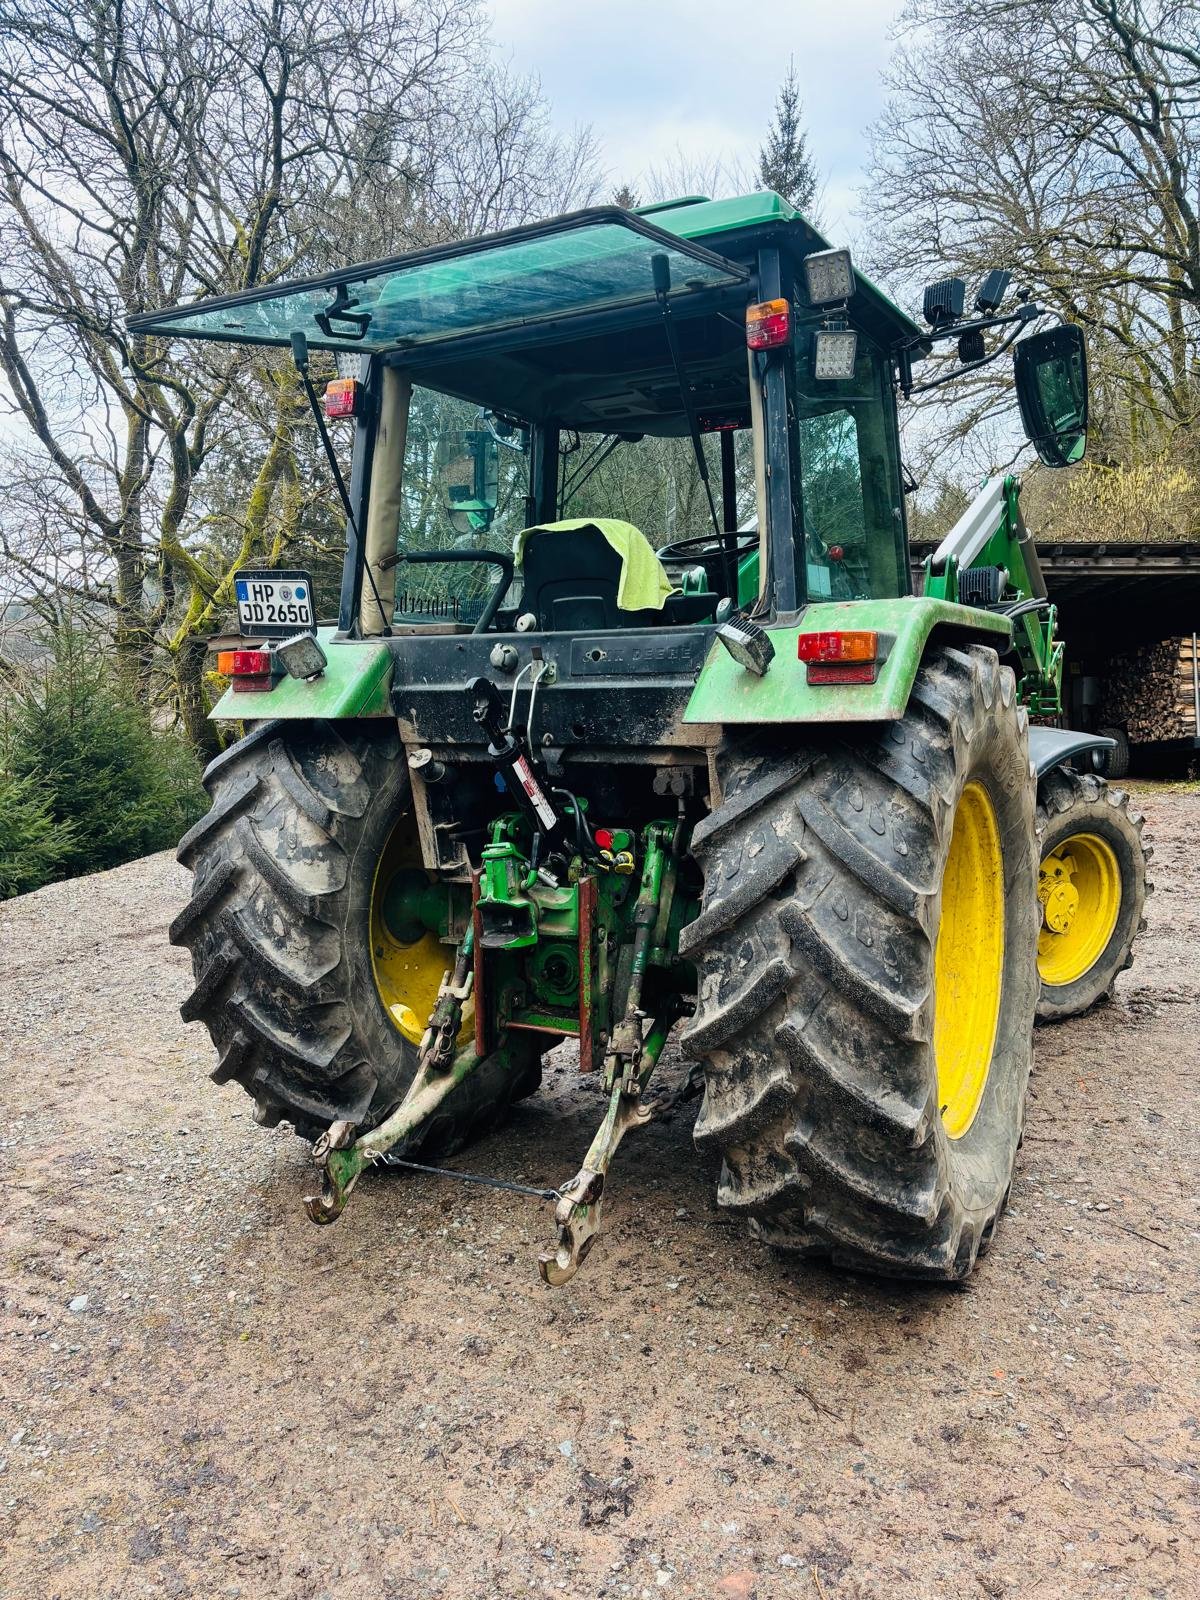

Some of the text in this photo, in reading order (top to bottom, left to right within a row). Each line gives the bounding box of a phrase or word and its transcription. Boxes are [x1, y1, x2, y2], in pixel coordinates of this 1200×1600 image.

[252, 584, 274, 603] HP
[243, 603, 309, 623] JD 2650
[632, 646, 691, 660] DEERE
